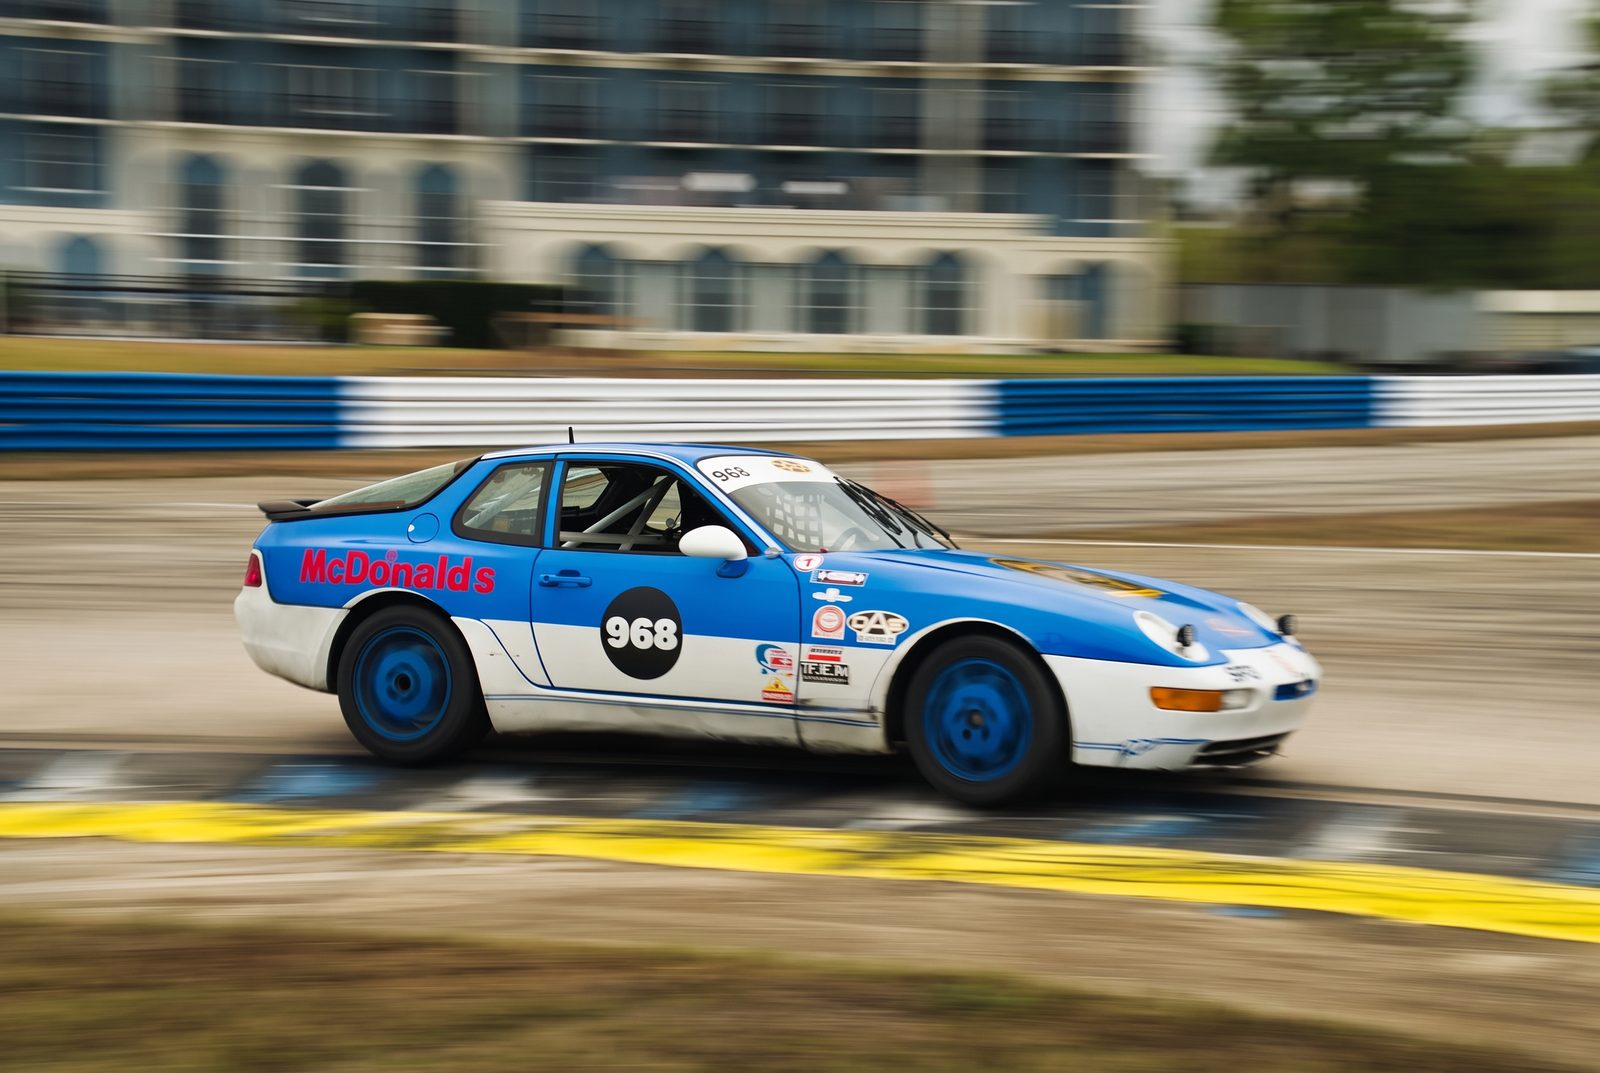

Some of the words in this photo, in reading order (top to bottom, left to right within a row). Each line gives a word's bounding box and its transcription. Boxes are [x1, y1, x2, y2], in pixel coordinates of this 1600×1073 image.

[712, 466, 751, 482] 968
[299, 548, 496, 594] McDonalds
[605, 616, 678, 651] 968
